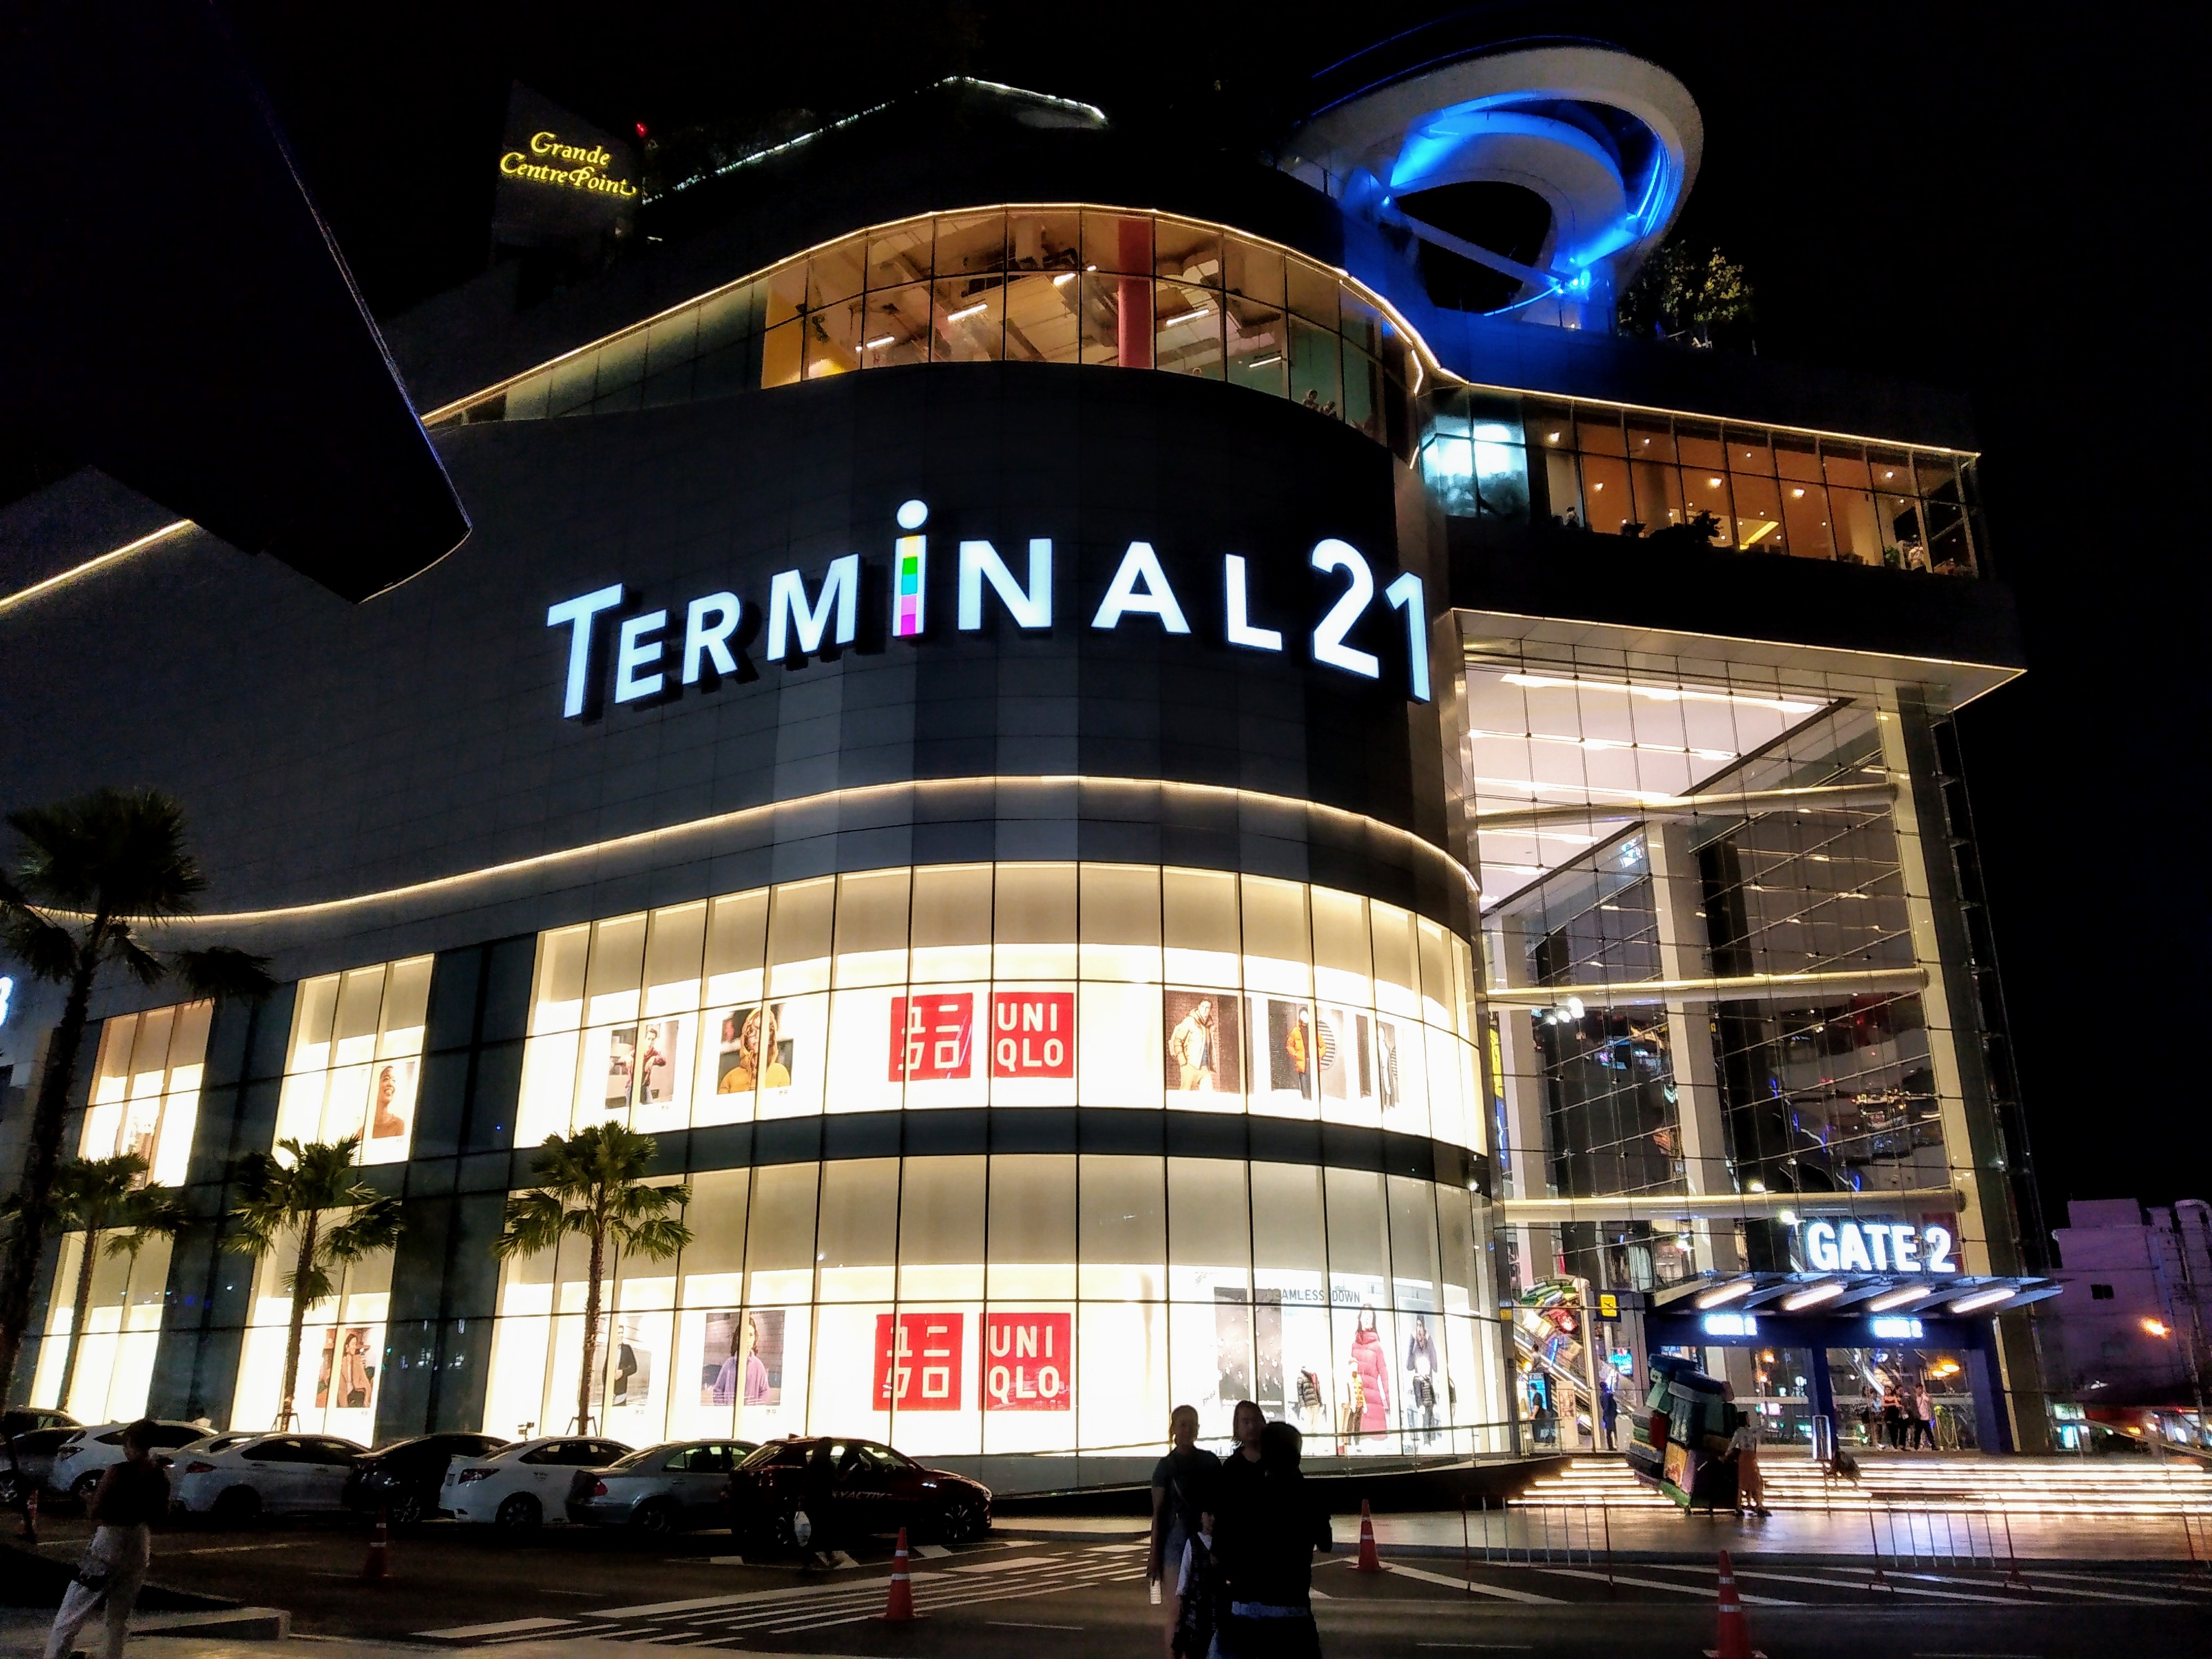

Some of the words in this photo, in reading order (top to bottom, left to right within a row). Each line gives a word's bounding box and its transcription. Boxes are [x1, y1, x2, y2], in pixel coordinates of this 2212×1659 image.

[530, 132, 611, 165] Grande
[1312, 538, 1431, 703] 21
[997, 1003, 1057, 1031] UNI
[997, 1038, 1063, 1072] QLO
[1807, 1222, 1921, 1271] GATE
[1926, 1227, 1955, 1272] 2
[1332, 1290, 1360, 1303] DOWN
[990, 1325, 1053, 1358] UNI
[989, 1365, 1060, 1404] QLO
